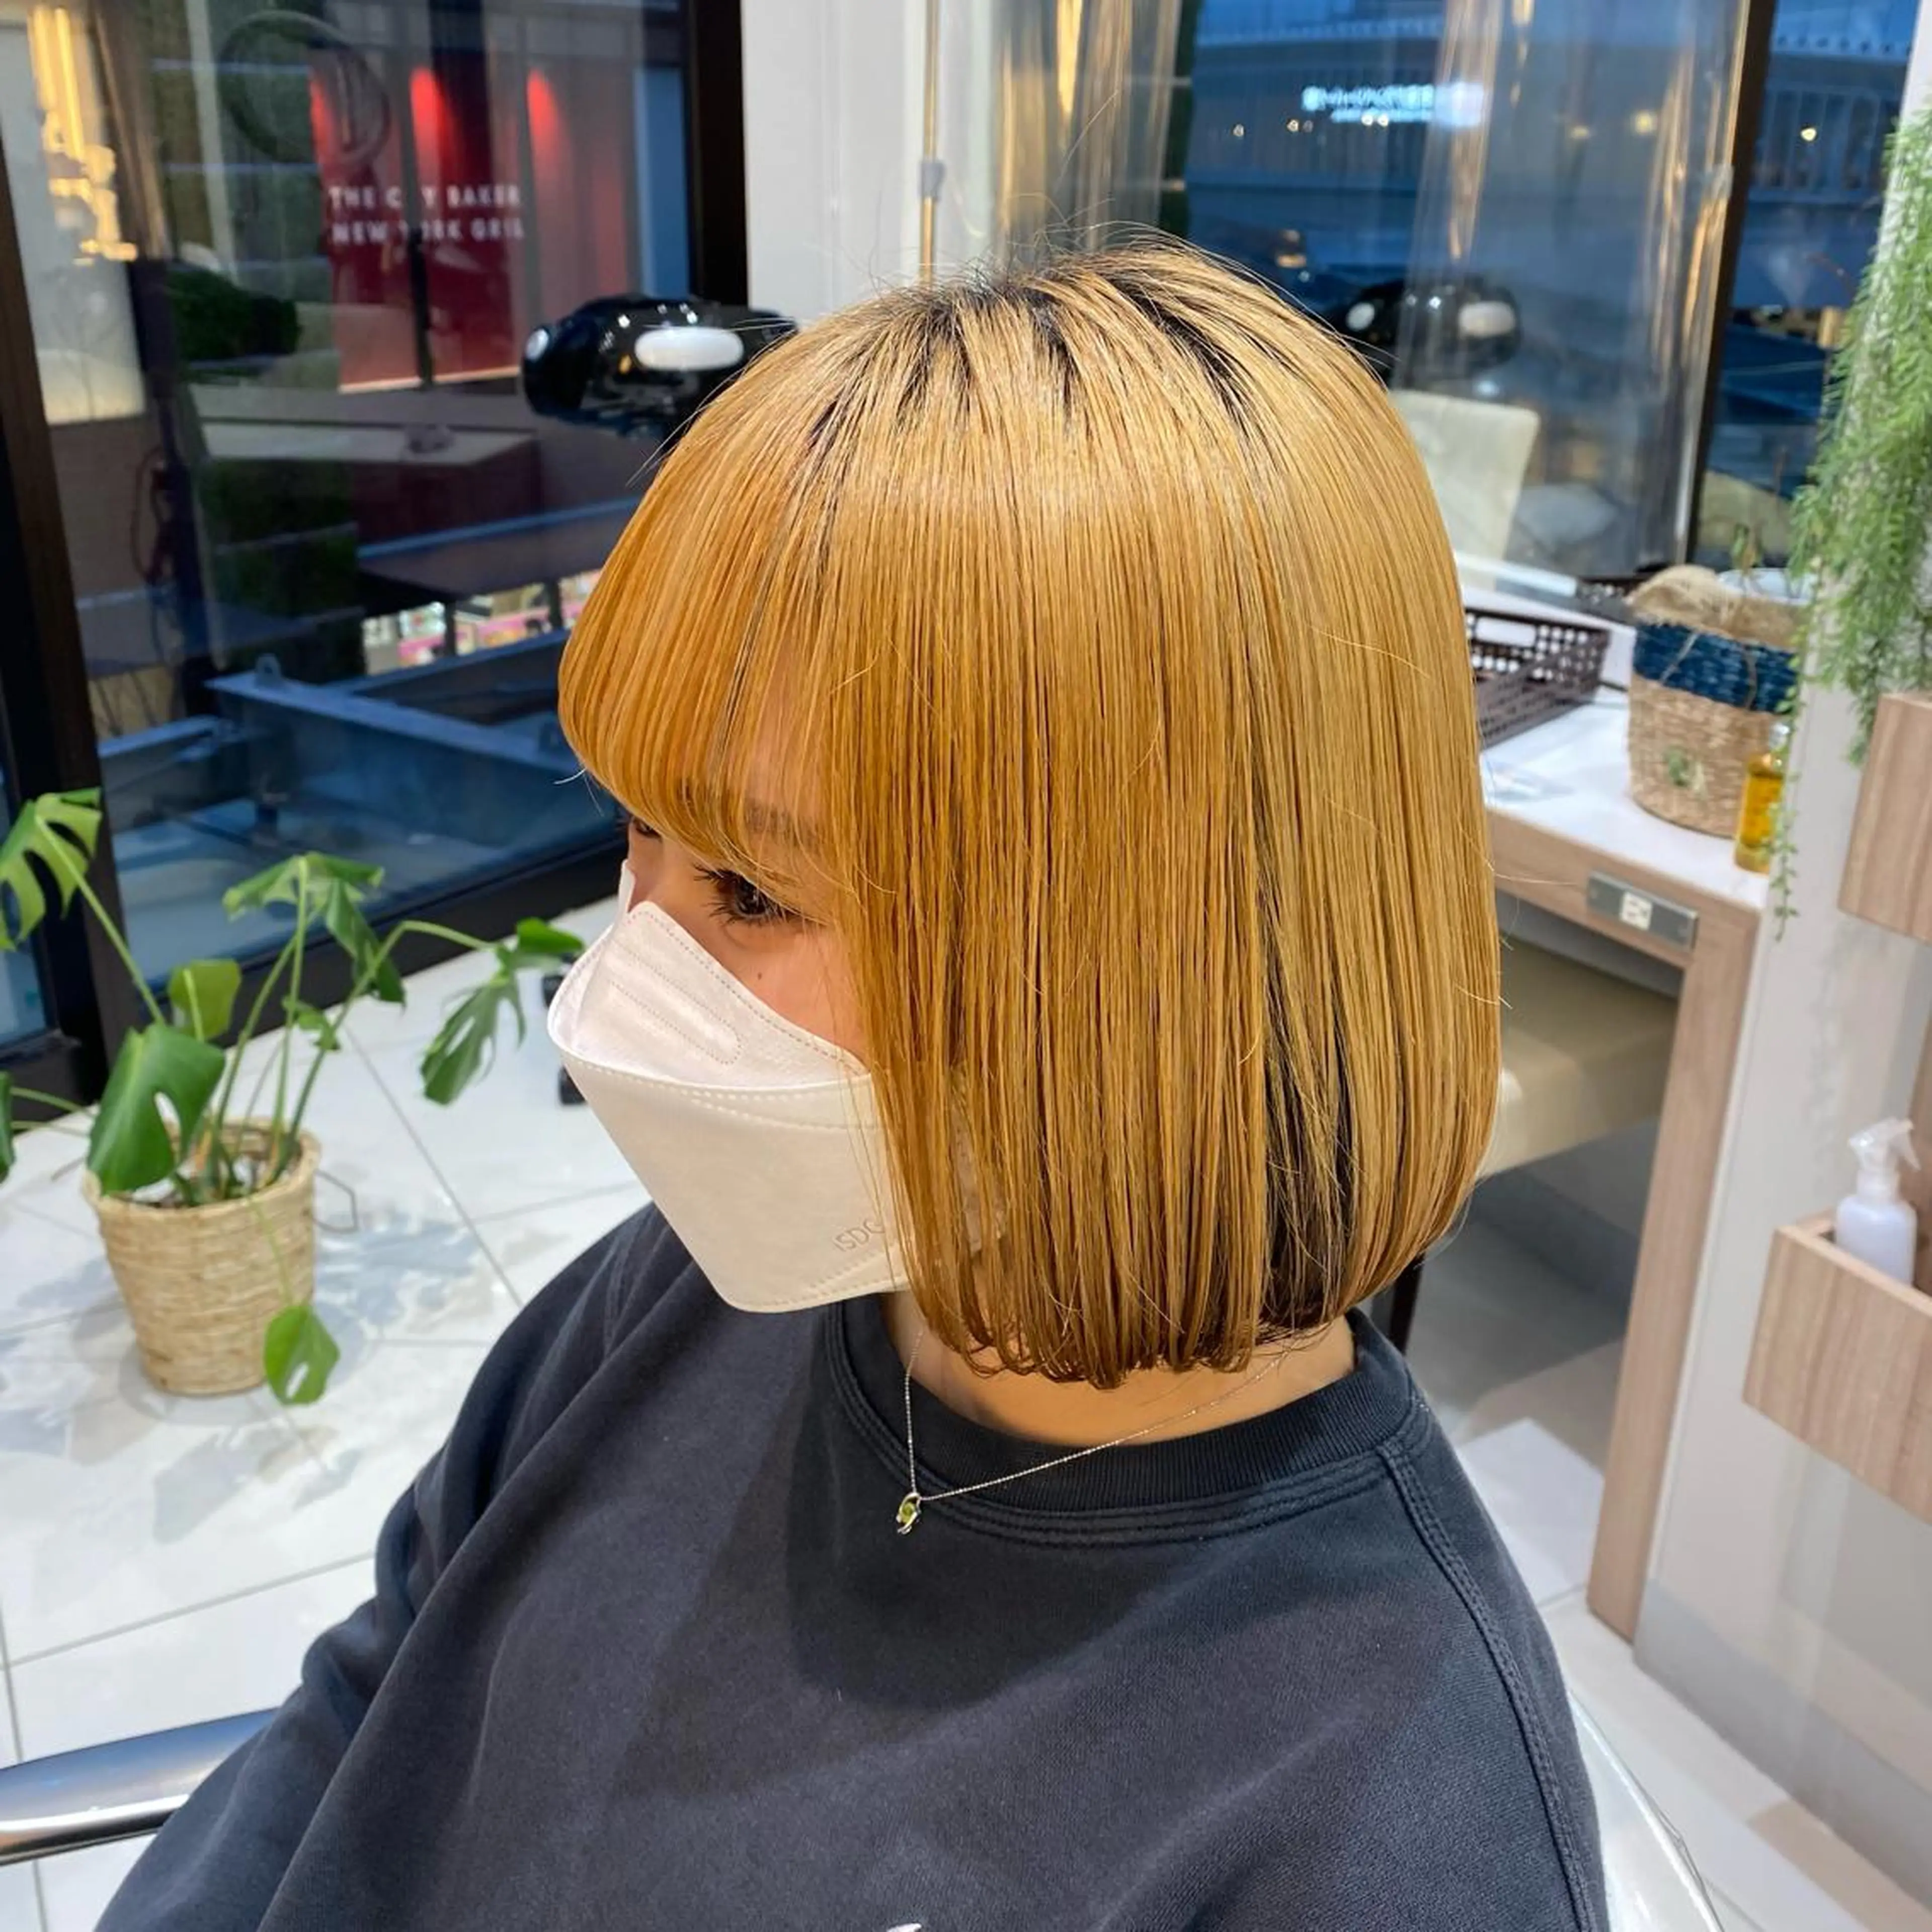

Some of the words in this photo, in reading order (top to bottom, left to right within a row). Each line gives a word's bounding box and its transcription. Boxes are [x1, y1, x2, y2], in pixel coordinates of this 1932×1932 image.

[329, 186, 374, 209] THE
[385, 186, 437, 208] CY
[447, 185, 520, 207] BAKER
[332, 221, 388, 246] NEW
[471, 217, 524, 242] GRIL
